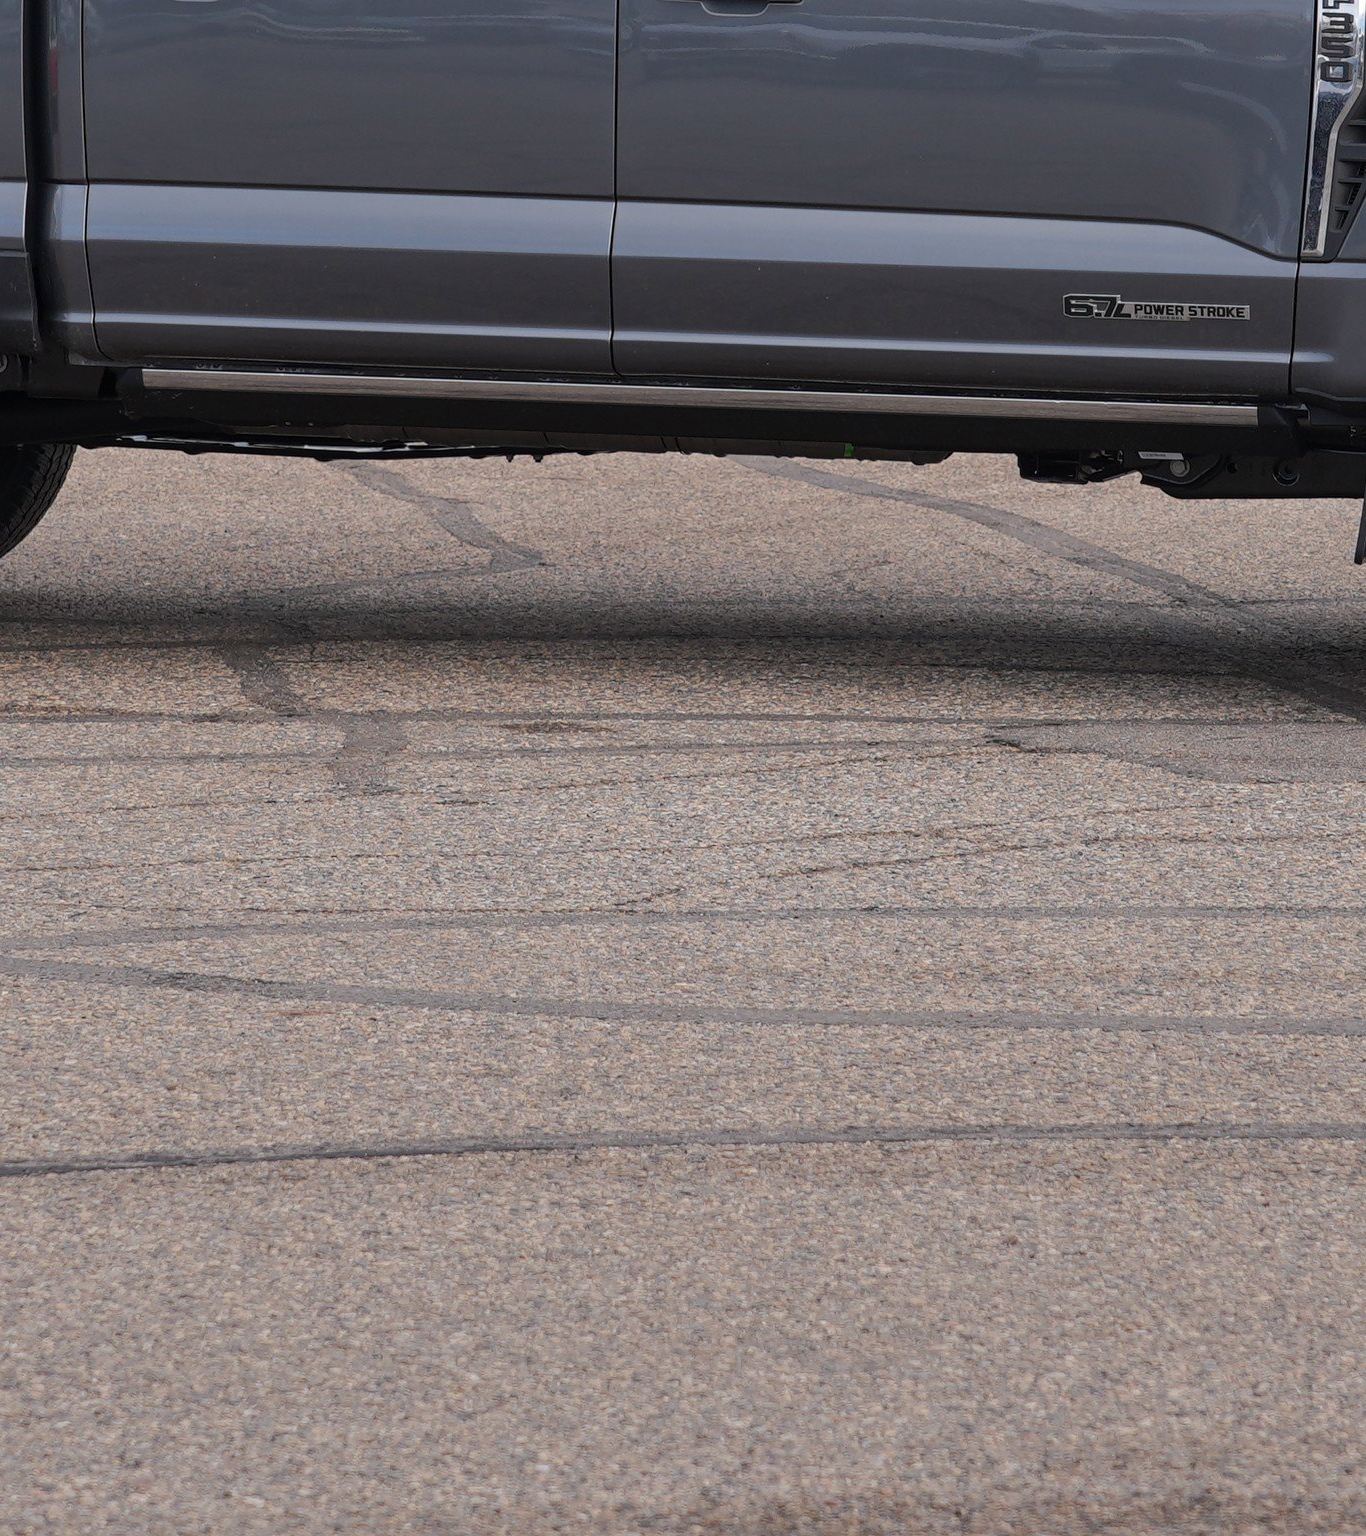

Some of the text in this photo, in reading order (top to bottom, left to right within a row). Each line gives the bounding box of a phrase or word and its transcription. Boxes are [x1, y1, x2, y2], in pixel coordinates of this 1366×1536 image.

[1063, 294, 1246, 318] 6.7L POWER STROKE
